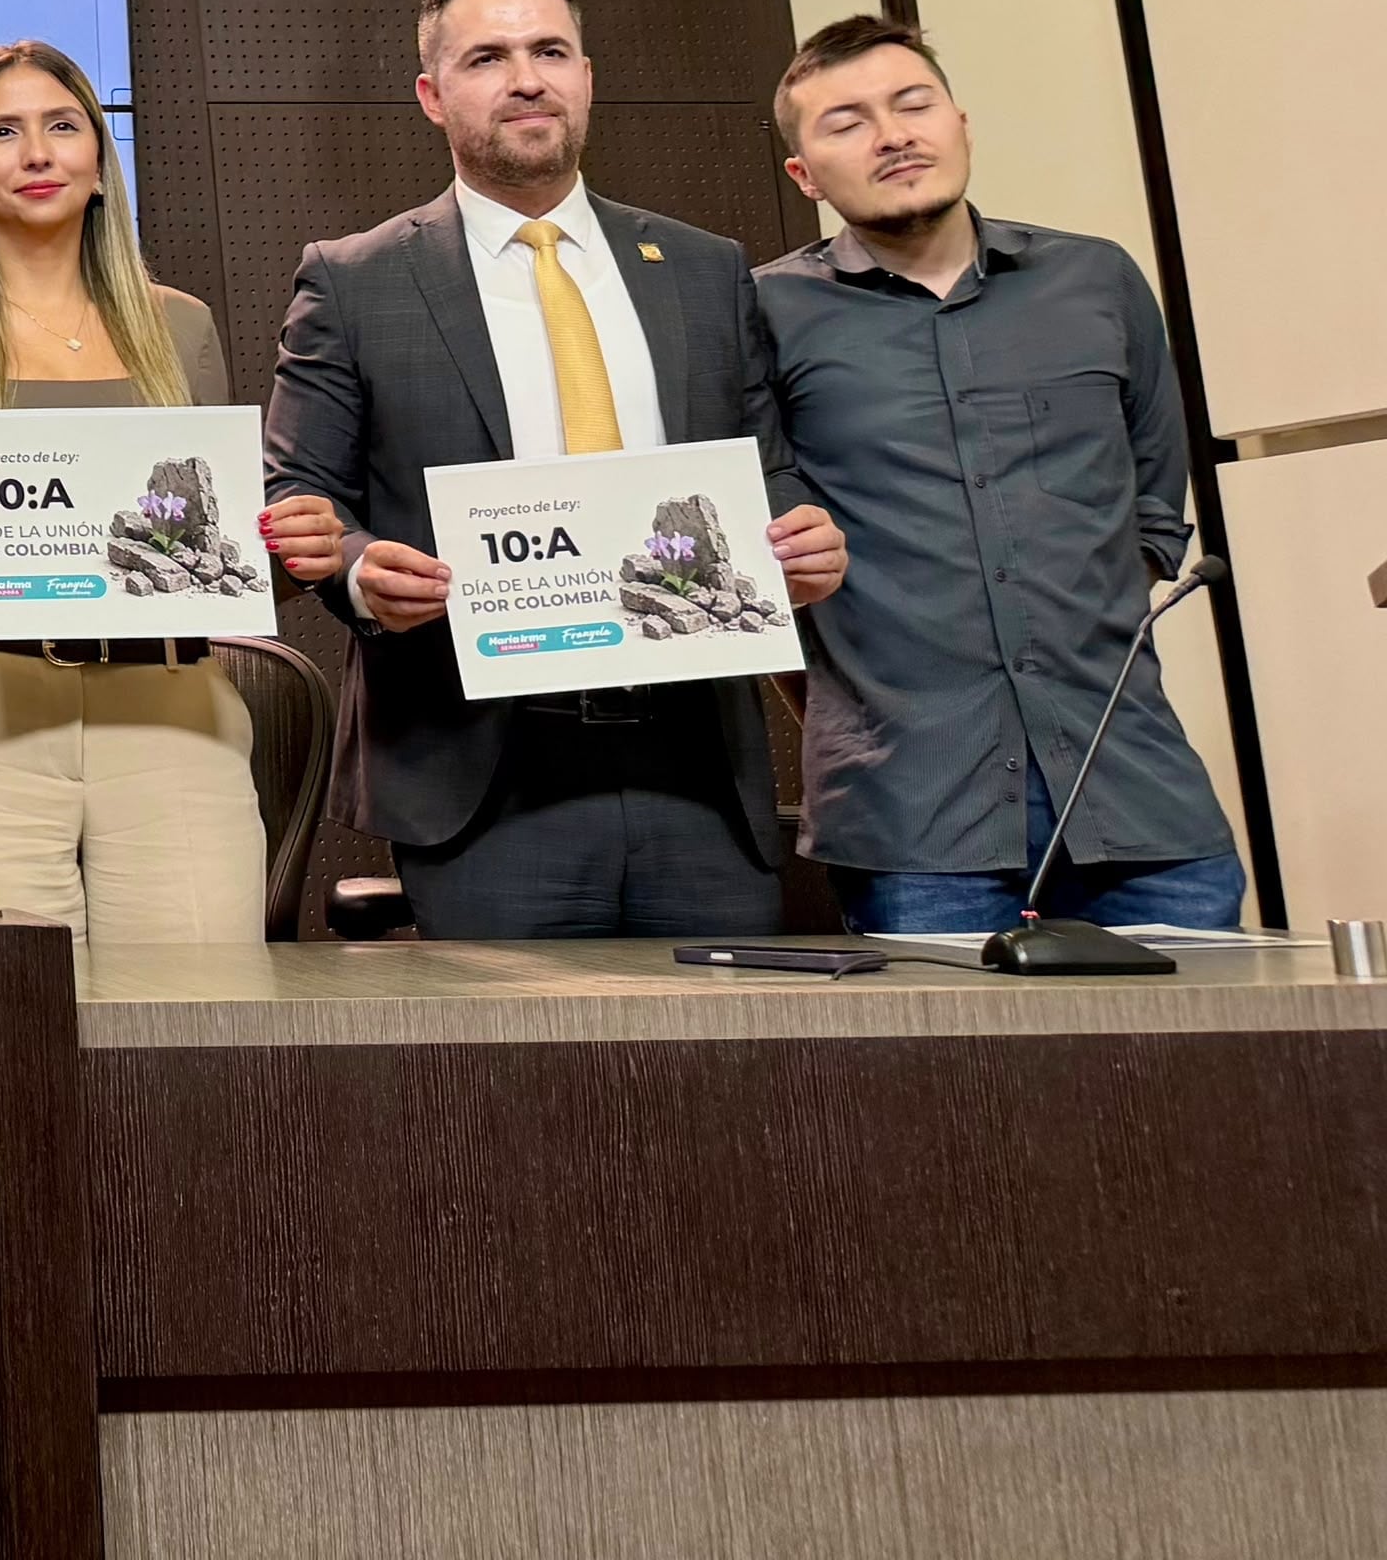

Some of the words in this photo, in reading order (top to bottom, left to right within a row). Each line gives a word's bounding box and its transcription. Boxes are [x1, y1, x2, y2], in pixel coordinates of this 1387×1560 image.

[33, 451, 50, 462] de
[52, 451, 79, 465] Ley:
[469, 504, 530, 519] Proyecto
[533, 501, 551, 512] de
[553, 500, 581, 512] Ley:
[19, 525, 41, 538] LA
[45, 521, 103, 537] UNIÓN
[480, 526, 582, 564] 10:A
[462, 579, 494, 596] DÍA
[498, 578, 523, 593] DE
[527, 576, 551, 590] LA
[554, 569, 614, 587] UNIÓN
[470, 599, 510, 614] POR
